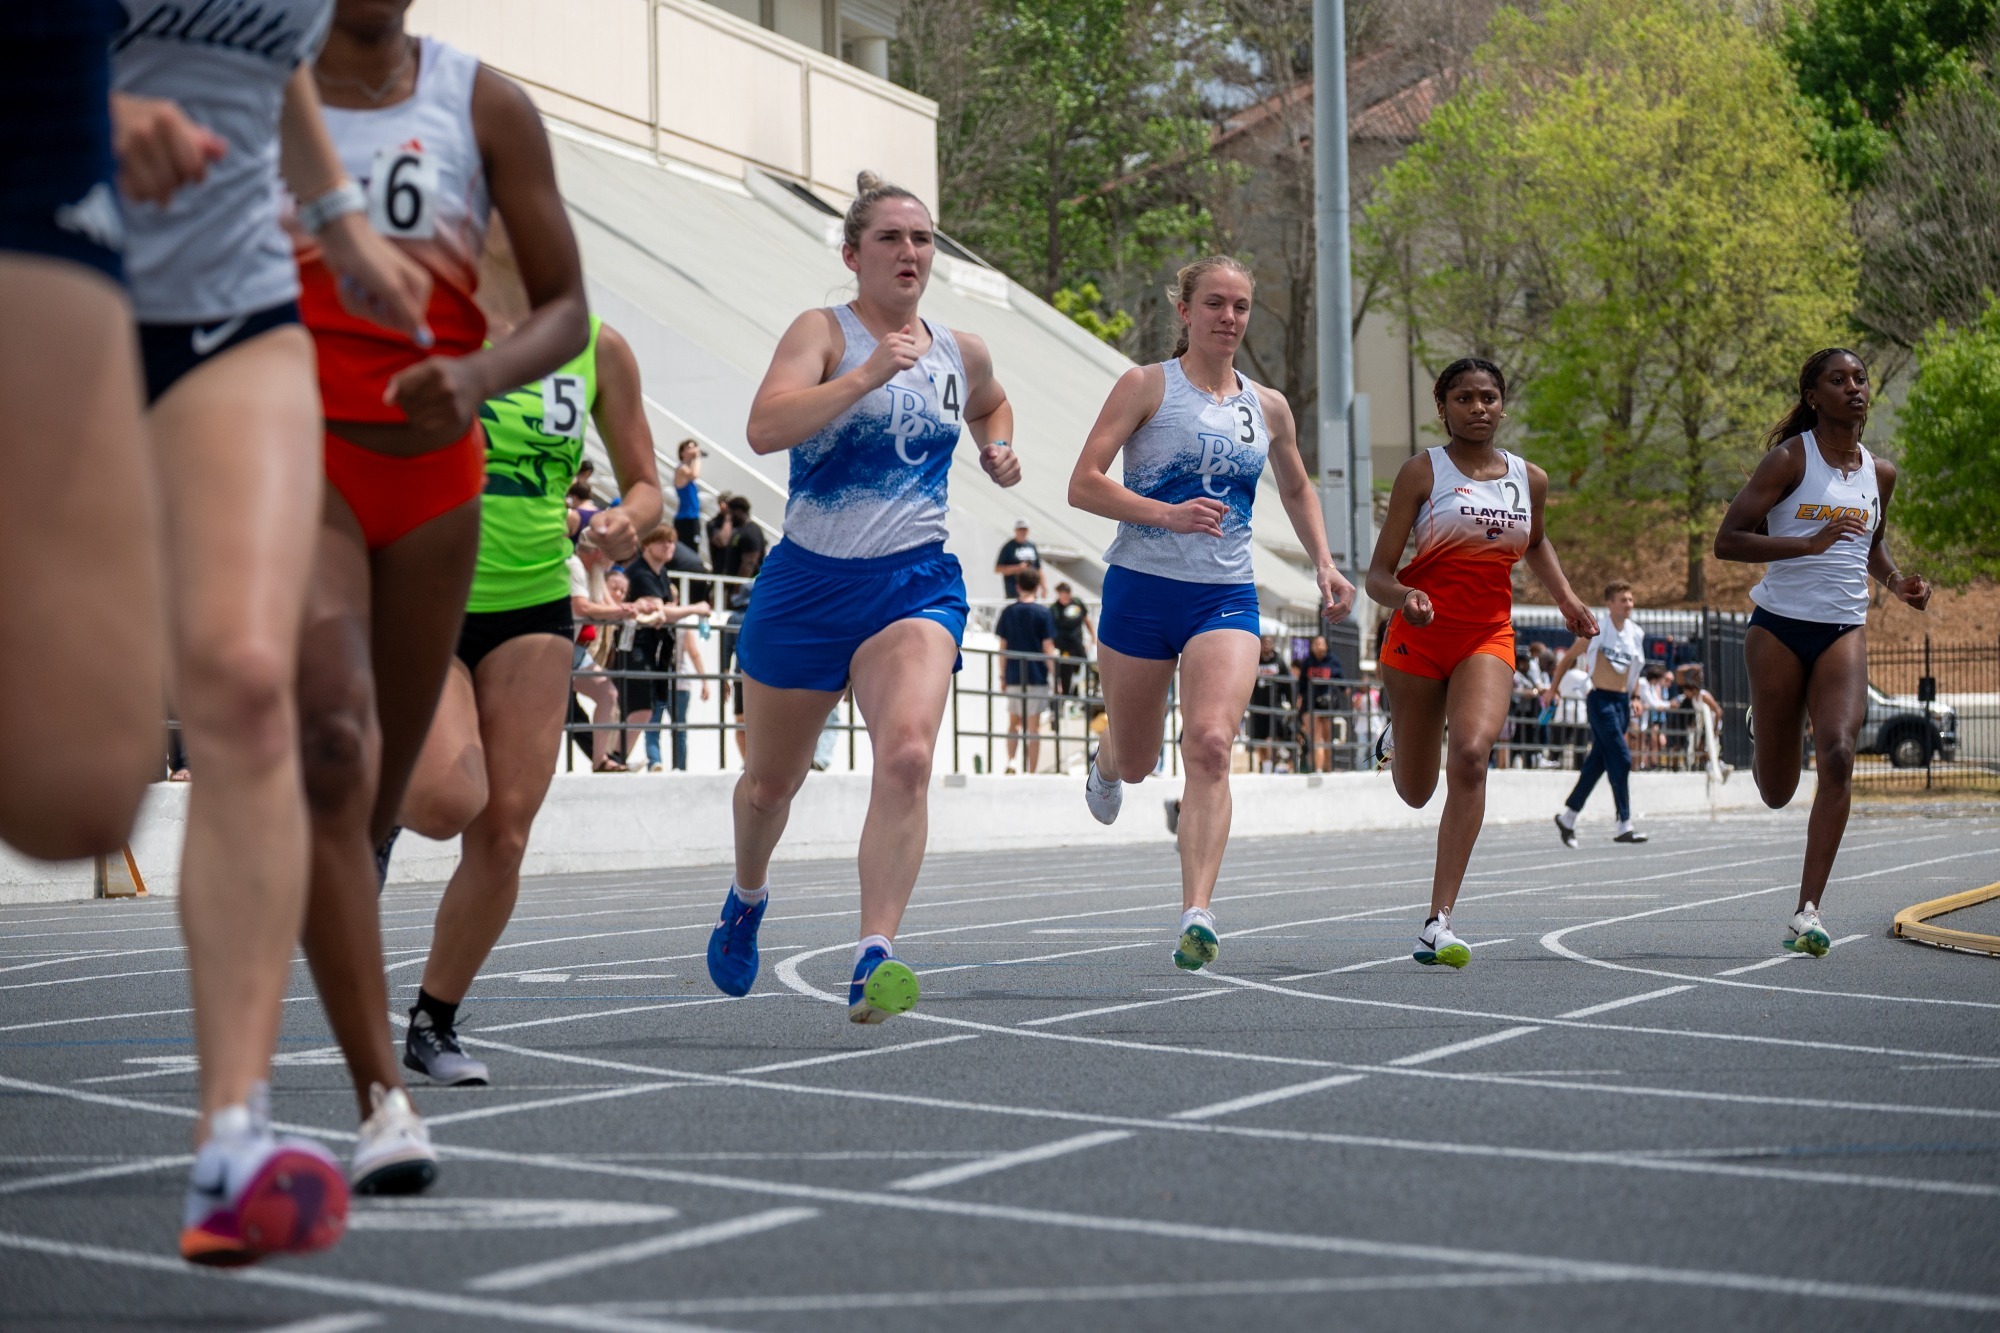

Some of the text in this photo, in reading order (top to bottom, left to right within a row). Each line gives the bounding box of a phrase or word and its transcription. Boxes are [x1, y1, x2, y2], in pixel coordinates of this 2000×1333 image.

[385, 154, 423, 231] 6
[554, 378, 577, 432] 5
[943, 374, 960, 421] 4
[883, 384, 938, 466] BC
[1237, 406, 1256, 444] 3
[1192, 432, 1241, 498] BC
[1504, 481, 1527, 514] 2
[1475, 517, 1515, 529] STATE
